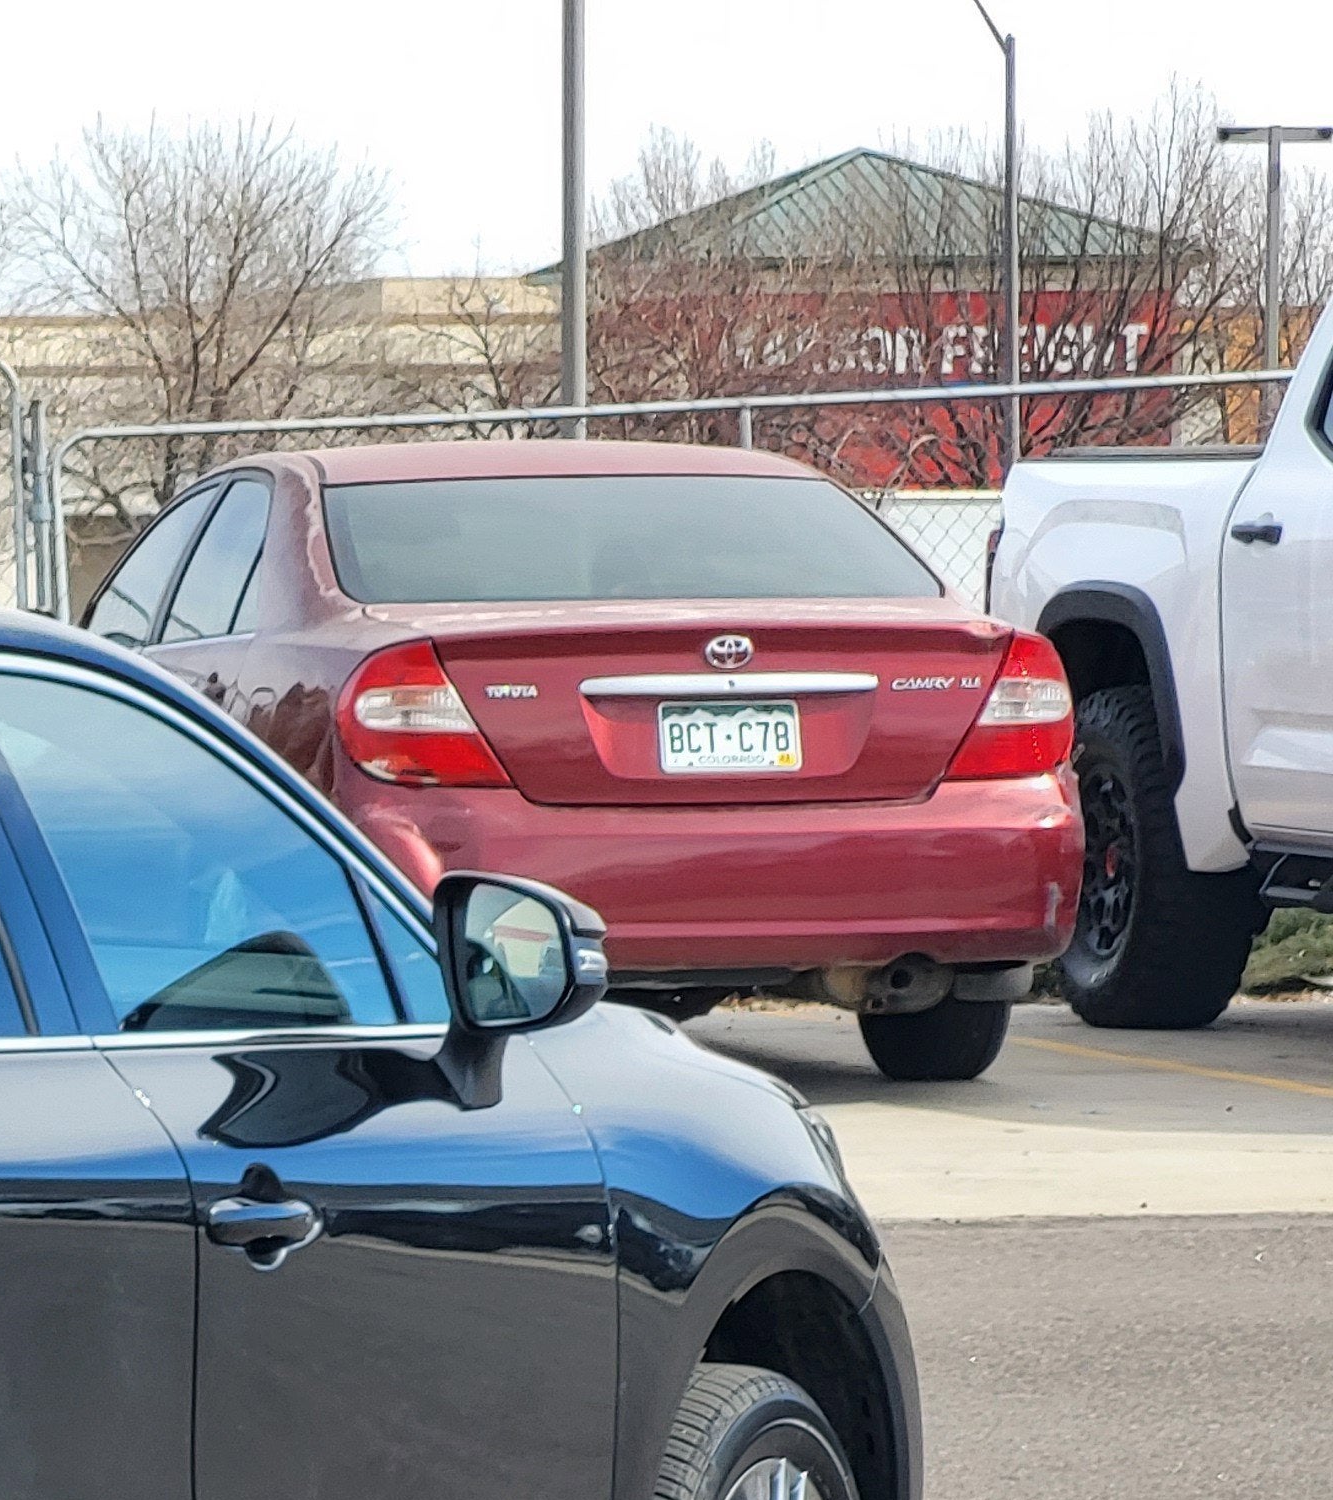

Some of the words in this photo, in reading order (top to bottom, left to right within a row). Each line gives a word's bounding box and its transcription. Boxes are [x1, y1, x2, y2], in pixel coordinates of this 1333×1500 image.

[891, 676, 955, 690] CAMRY
[485, 684, 539, 699] TOYOTA
[698, 754, 765, 765] COLORADO
